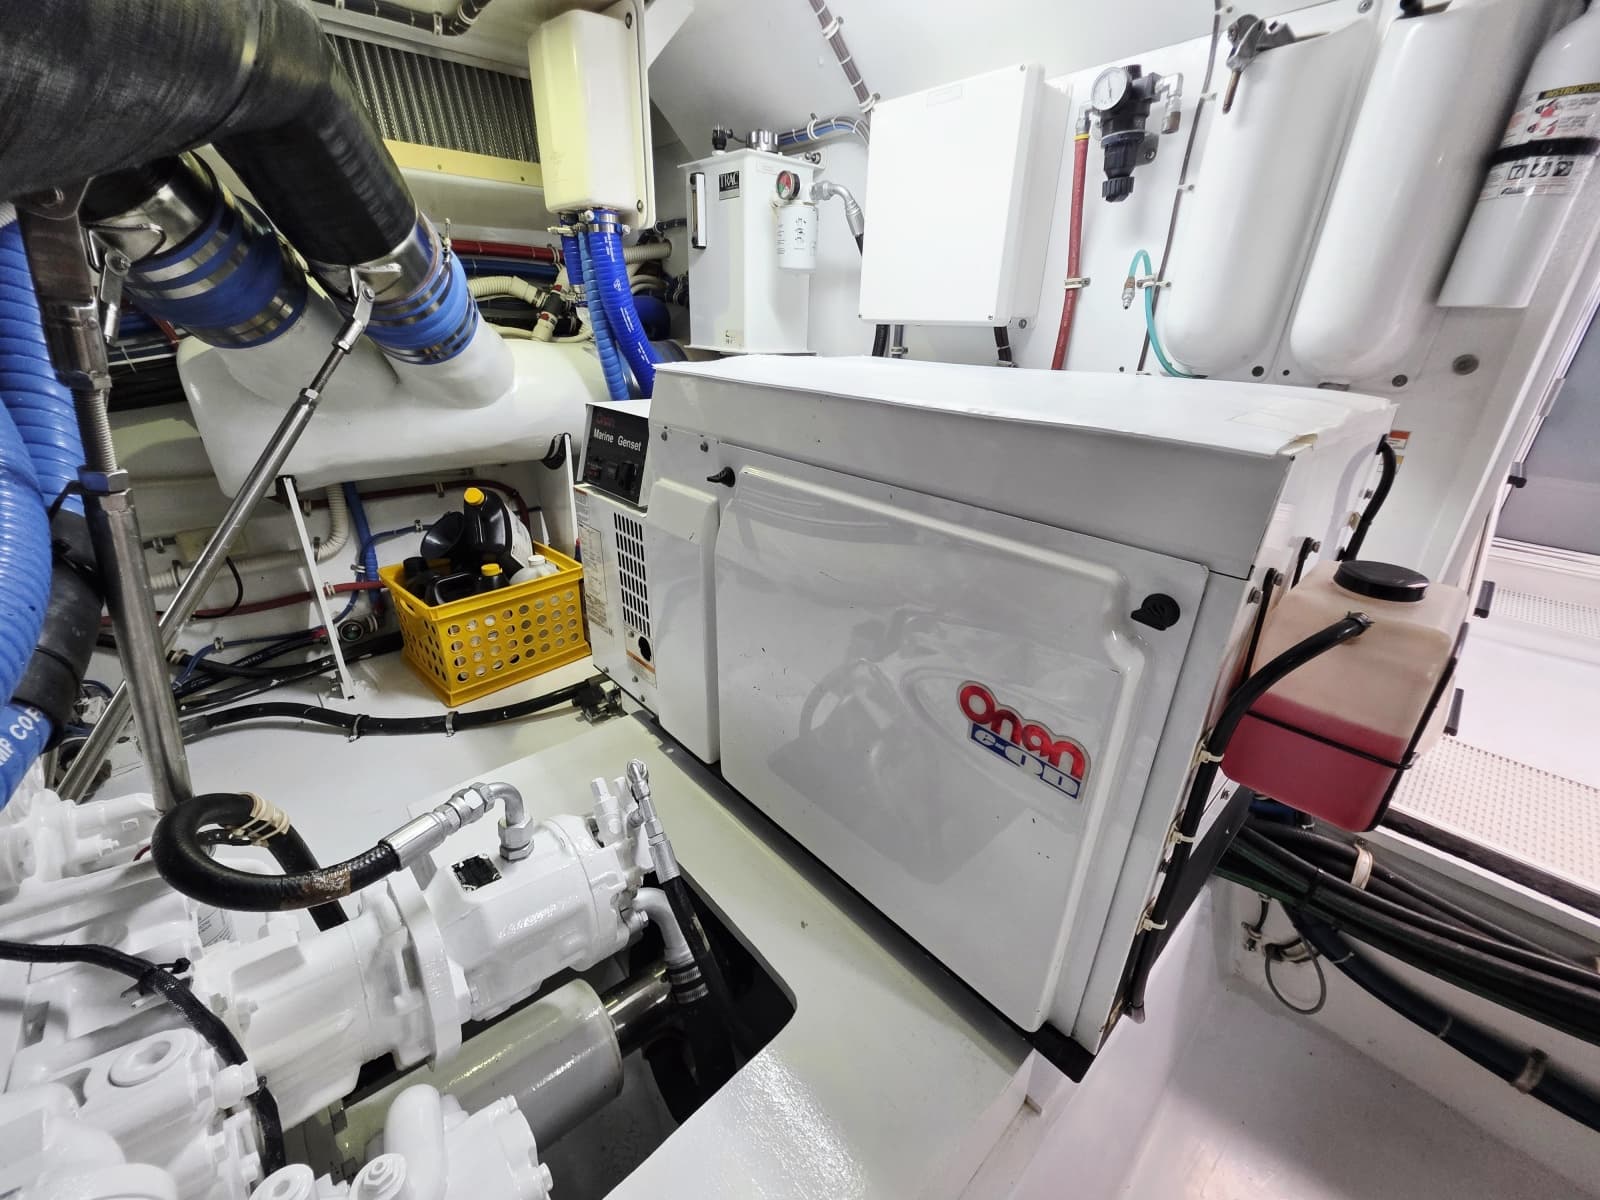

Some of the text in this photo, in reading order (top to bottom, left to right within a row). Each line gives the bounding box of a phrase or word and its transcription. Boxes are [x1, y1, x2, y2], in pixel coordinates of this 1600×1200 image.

[719, 172, 739, 188] TRAC
[594, 428, 642, 452] Marine Genset
